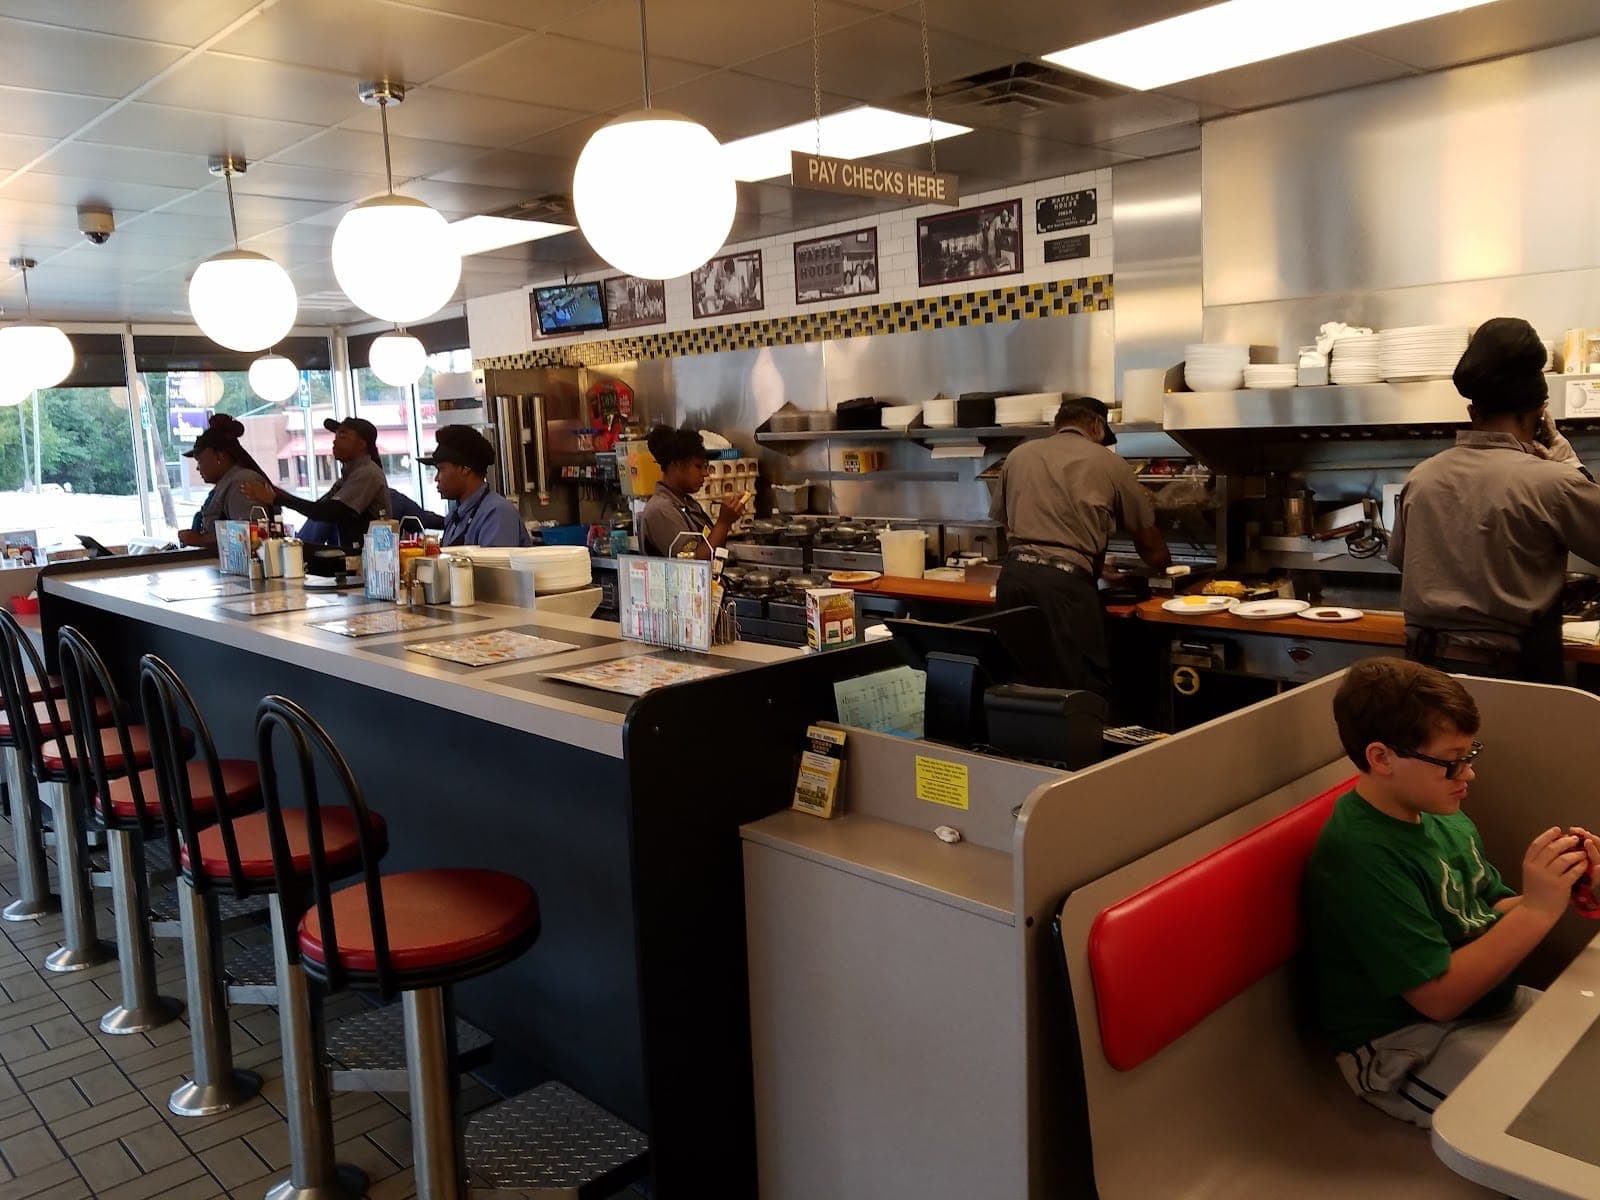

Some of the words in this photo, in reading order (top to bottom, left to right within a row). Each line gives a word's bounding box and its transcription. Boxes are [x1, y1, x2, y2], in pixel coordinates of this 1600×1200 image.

[808, 158, 838, 185] PAY
[842, 164, 904, 194] CHECKS
[907, 173, 946, 200] HERE
[798, 245, 841, 262] WAFFLE
[800, 262, 841, 280] HOUSE
